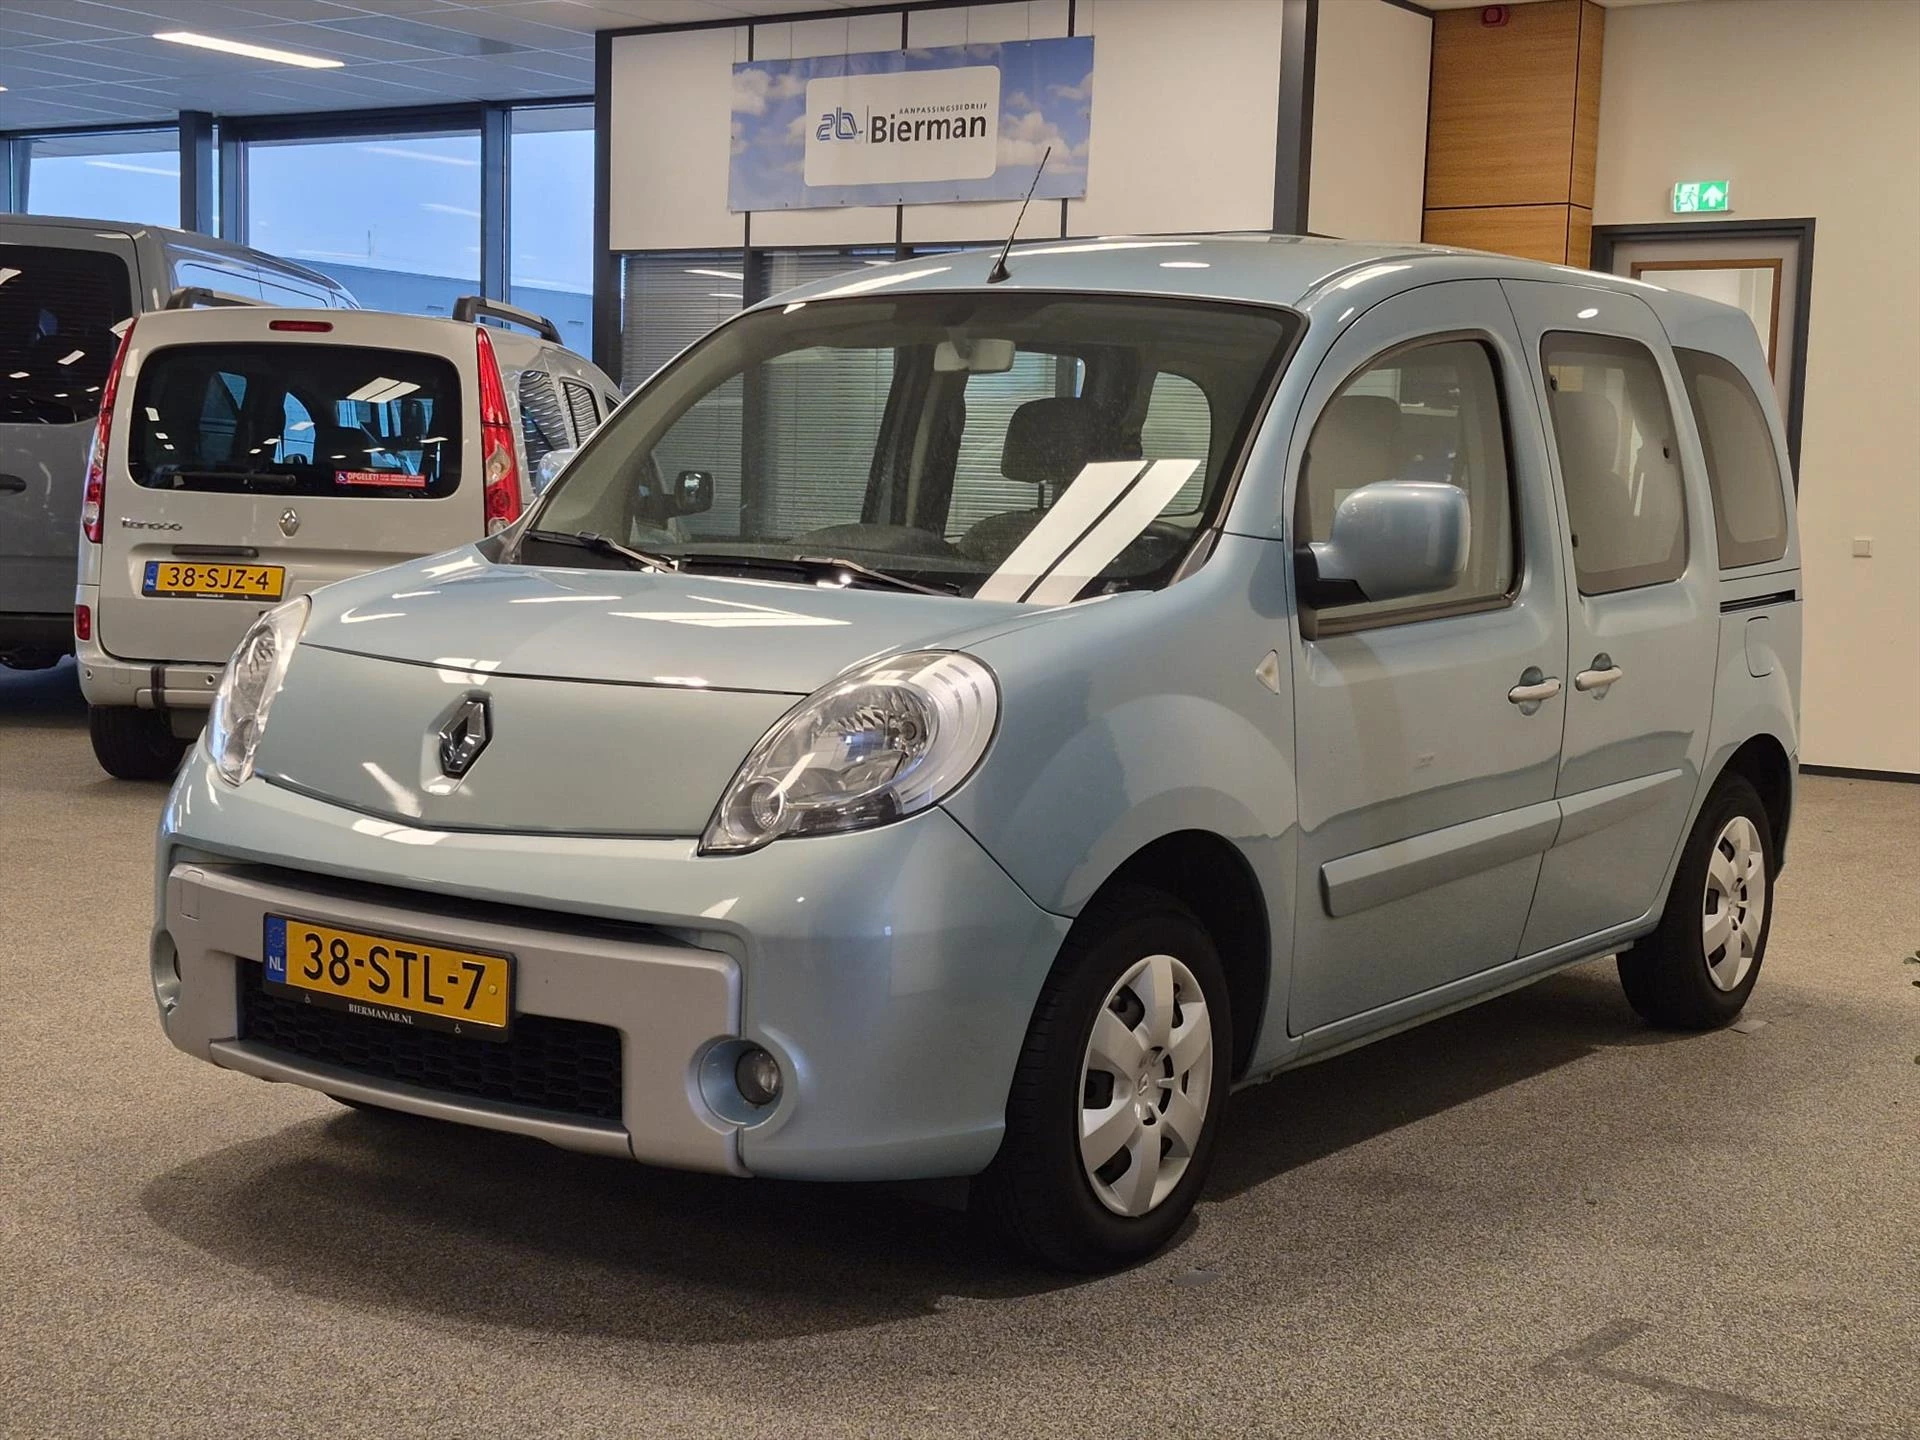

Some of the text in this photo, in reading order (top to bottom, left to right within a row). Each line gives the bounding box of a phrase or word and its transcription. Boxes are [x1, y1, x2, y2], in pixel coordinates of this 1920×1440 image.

[871, 114, 987, 144] Bierman
[167, 567, 270, 591] 38-SJZ-4
[268, 956, 284, 973] NL
[303, 932, 487, 1011] 38-STL-7
[348, 1003, 414, 1025] BIERMANAB.NL
